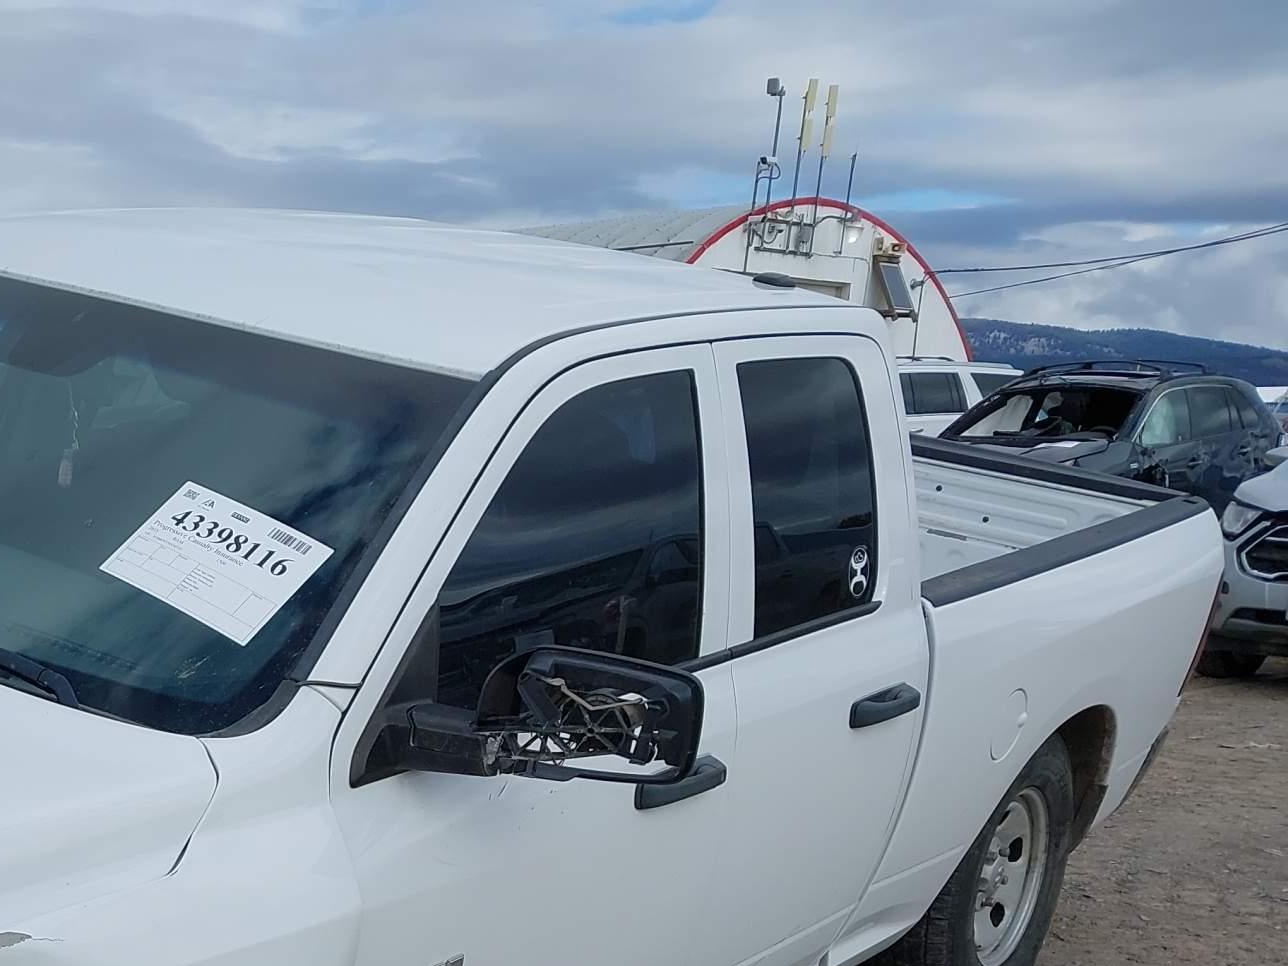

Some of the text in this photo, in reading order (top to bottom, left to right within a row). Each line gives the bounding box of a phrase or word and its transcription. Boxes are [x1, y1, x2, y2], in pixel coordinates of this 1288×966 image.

[153, 519, 187, 538] Progressive
[187, 535, 214, 552] Casualty
[214, 548, 245, 567] Insurance
[171, 511, 296, 576] 43398116
